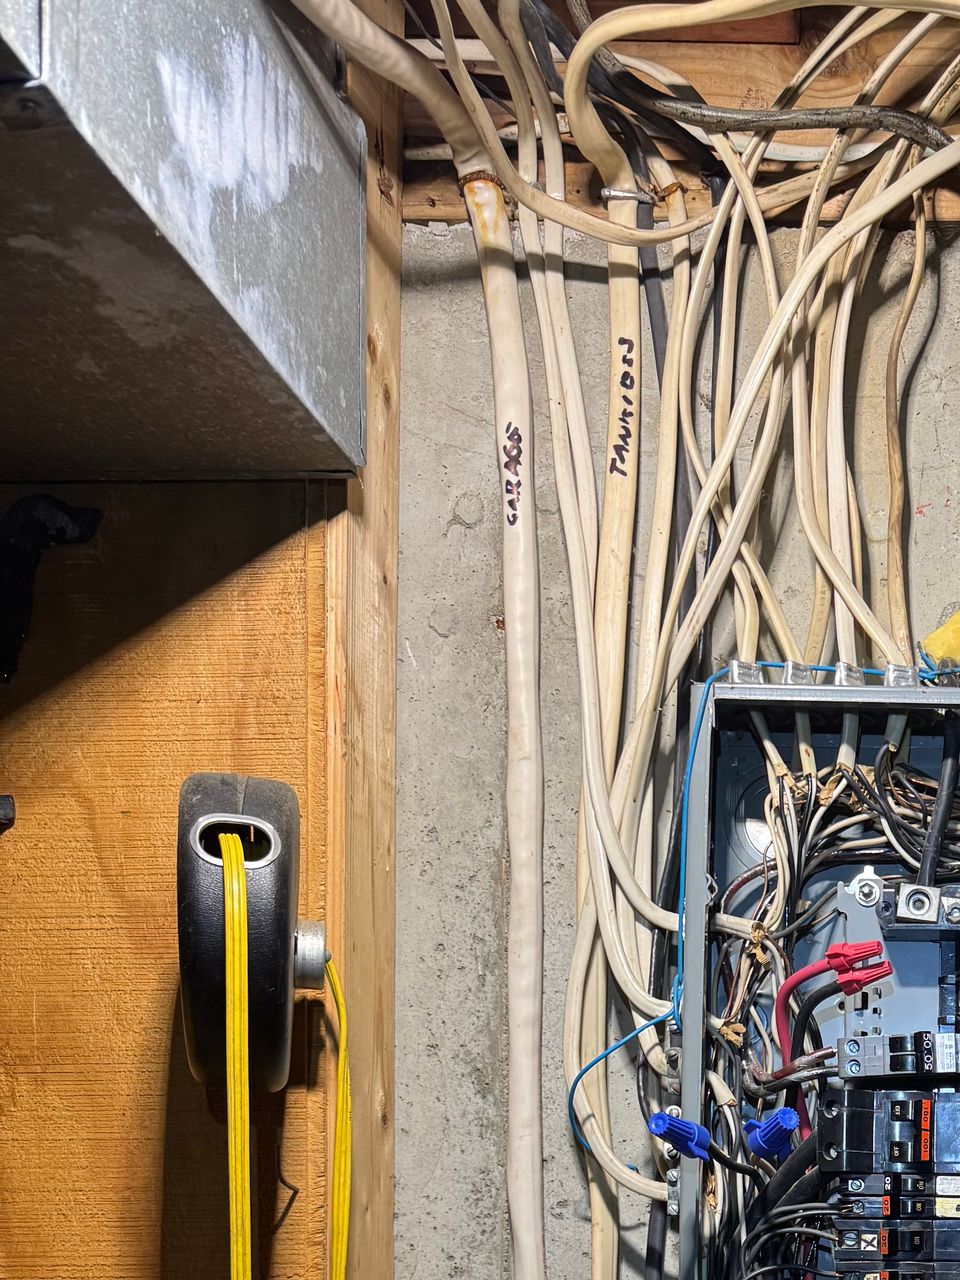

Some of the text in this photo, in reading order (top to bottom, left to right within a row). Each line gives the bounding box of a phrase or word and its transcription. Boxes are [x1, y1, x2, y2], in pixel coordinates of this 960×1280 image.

[924, 1055, 933, 1070] 50
[885, 1177, 891, 1190] 20
[883, 1200, 889, 1213] 20
[882, 1235, 887, 1247] 20
